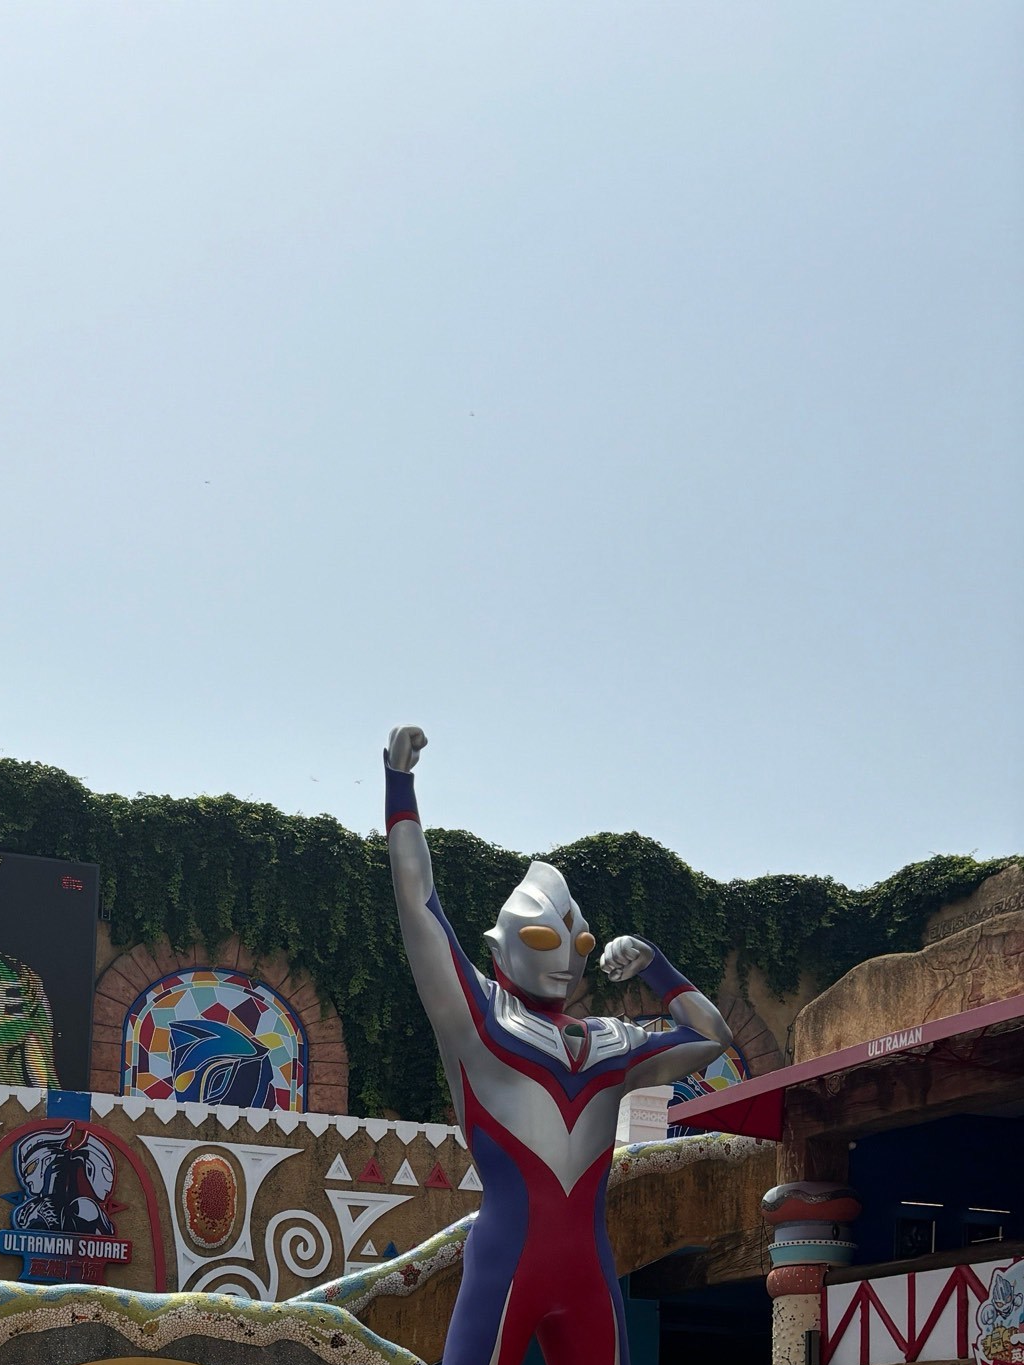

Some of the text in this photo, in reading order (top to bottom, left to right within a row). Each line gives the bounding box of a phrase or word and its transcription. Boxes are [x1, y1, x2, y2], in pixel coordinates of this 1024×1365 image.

[868, 1027, 922, 1057] ULTRAMAN
[4, 1234, 128, 1259] ULTRAMAN SQUARE
